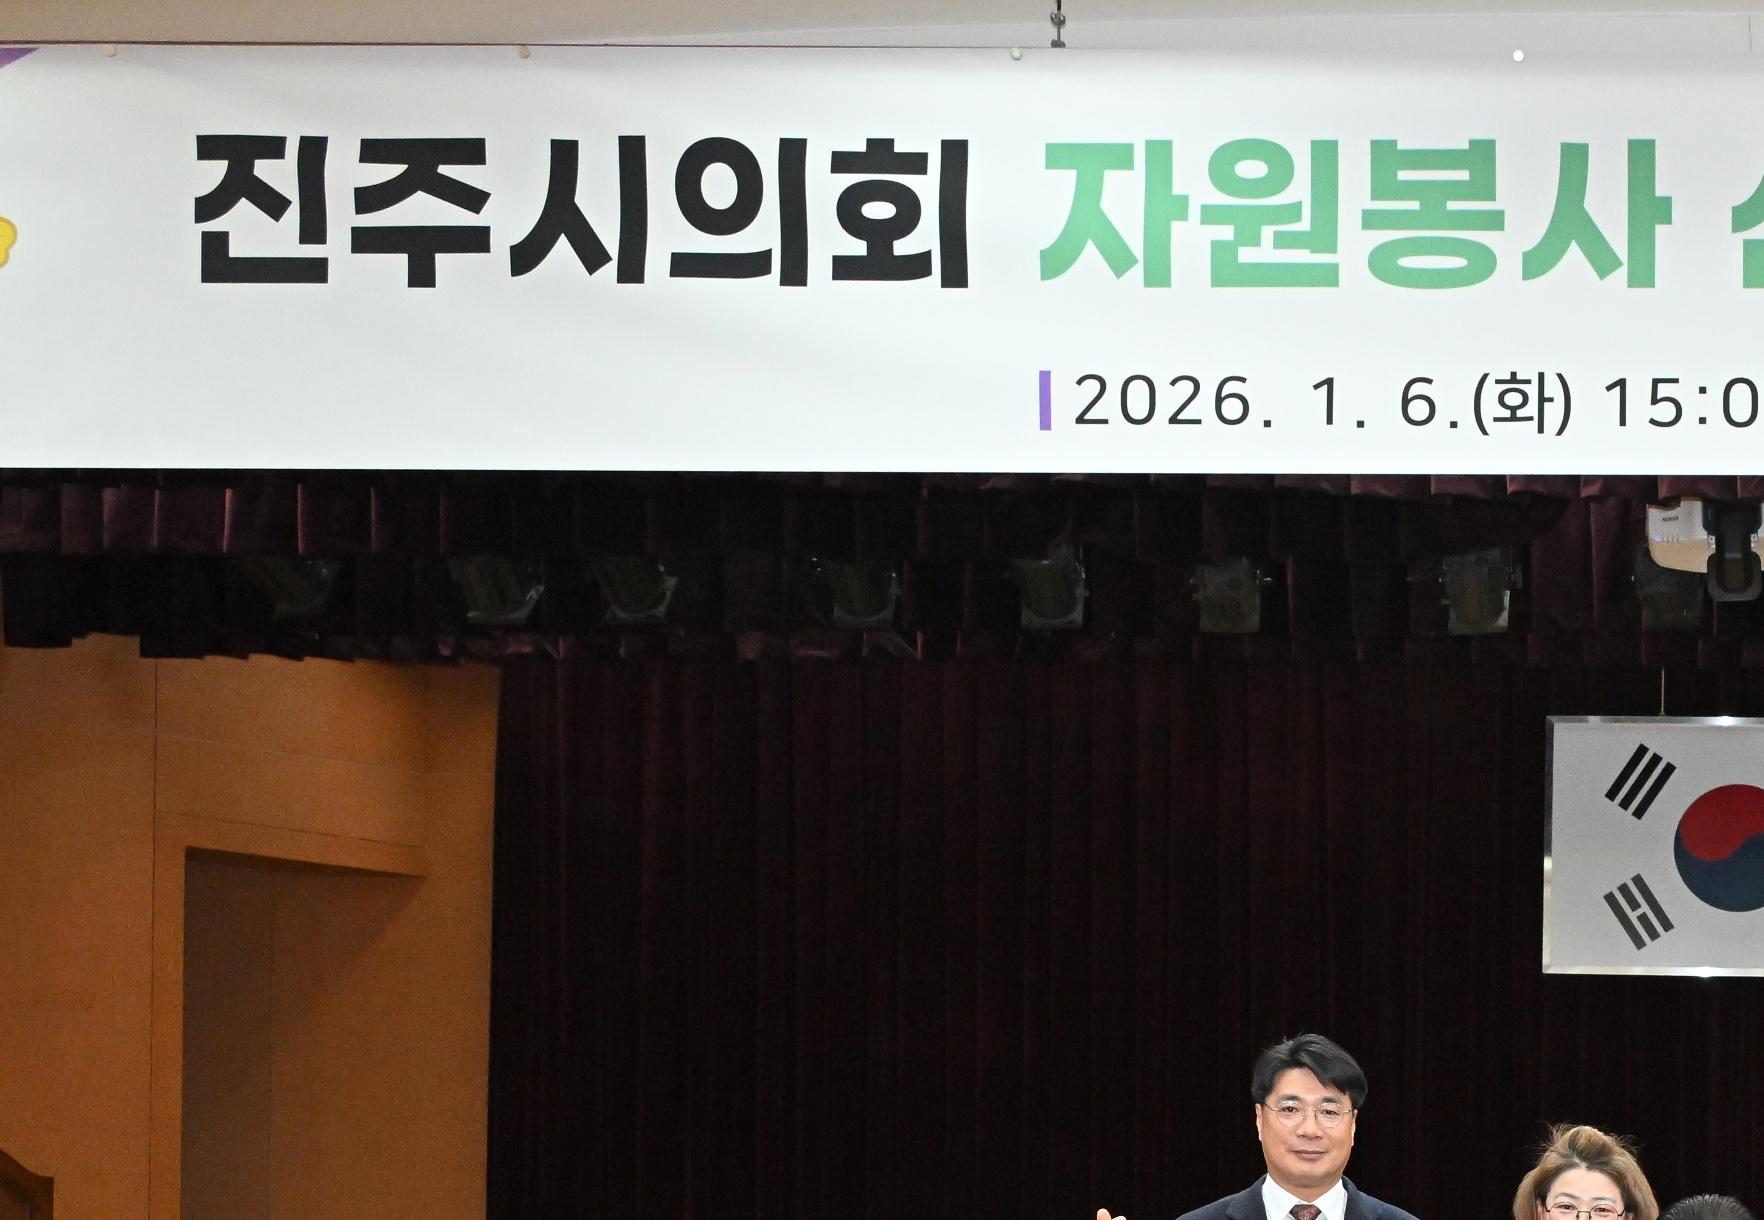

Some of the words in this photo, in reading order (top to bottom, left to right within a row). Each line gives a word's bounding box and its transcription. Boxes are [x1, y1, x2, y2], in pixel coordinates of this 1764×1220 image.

[194, 134, 969, 289] 진주시의회
[1039, 137, 1674, 289] 자원봉사
[1074, 374, 1273, 428] 2026.
[1311, 376, 1366, 428] 1.
